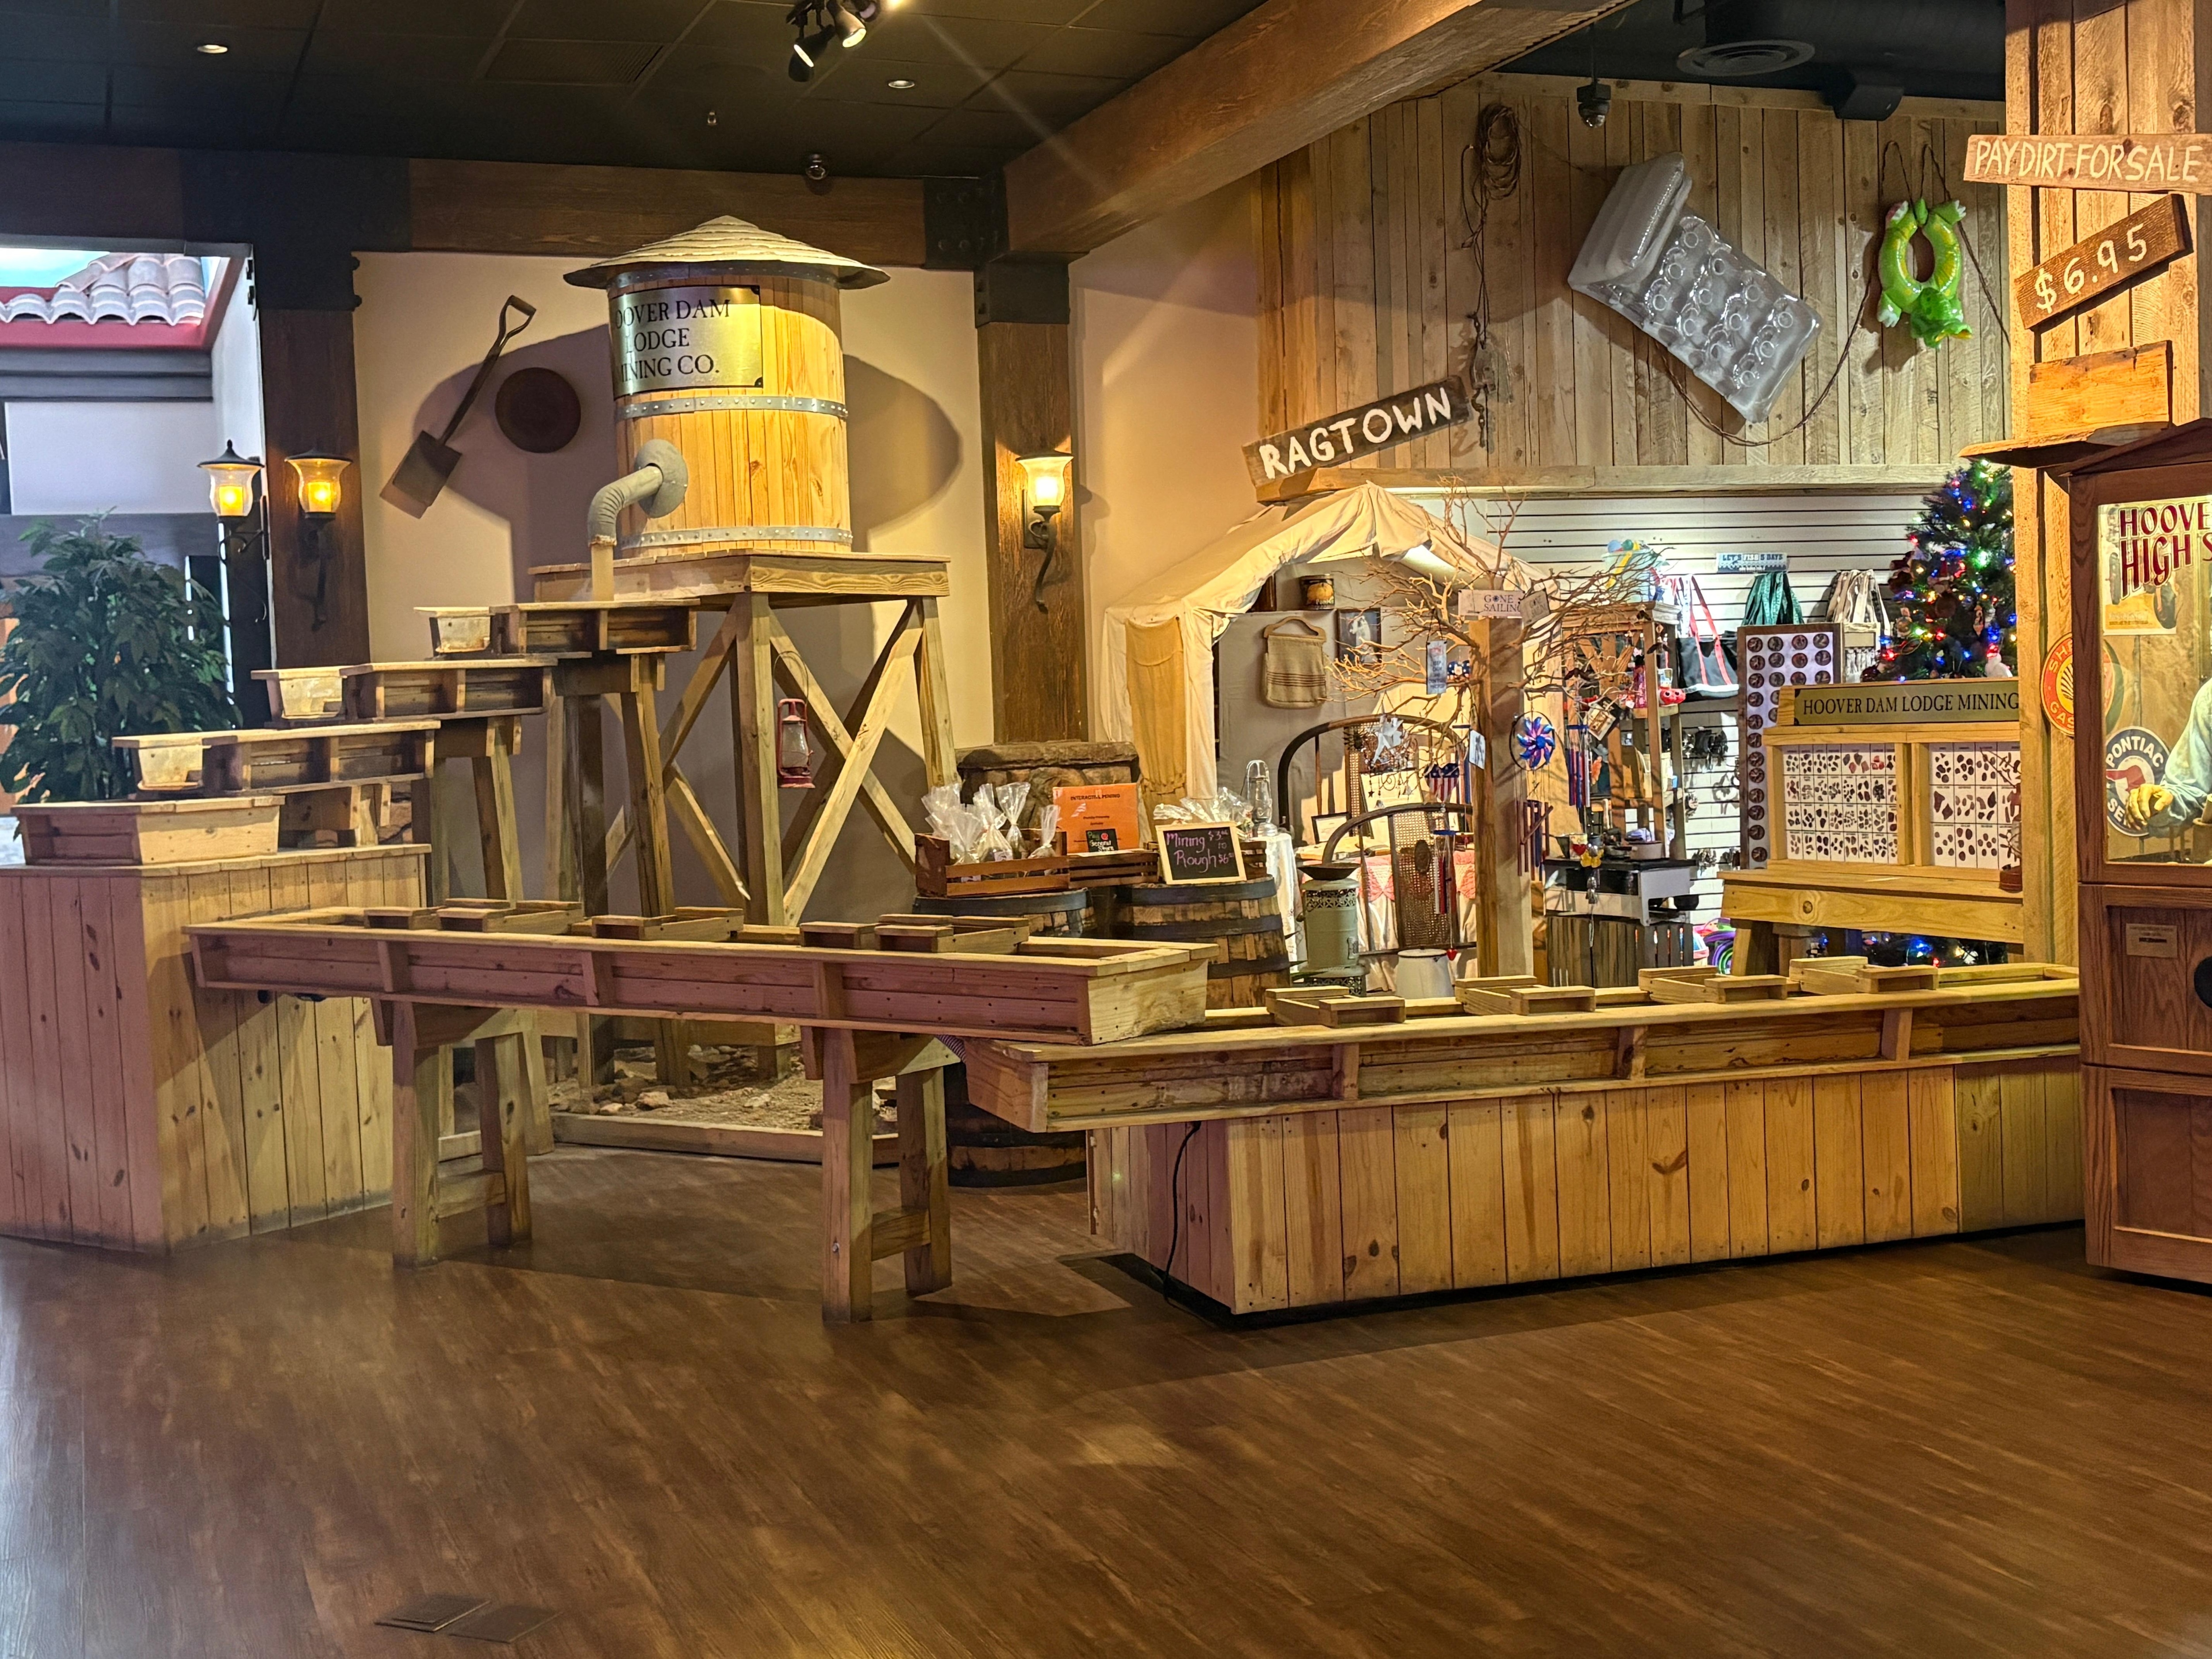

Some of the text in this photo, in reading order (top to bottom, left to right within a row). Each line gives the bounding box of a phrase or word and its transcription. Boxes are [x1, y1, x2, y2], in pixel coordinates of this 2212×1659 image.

[2074, 143, 2124, 180] FOR
[2125, 145, 2203, 181] SALE
[2035, 223, 2147, 314] $6.95
[676, 299, 730, 319] DAM
[622, 354, 719, 382] INING CO.
[1259, 387, 1451, 479] RAGTOWN
[2121, 534, 2191, 600] HIGH
[1803, 692, 2019, 715] HOOVER DAM LODGE MINING
[2106, 736, 2164, 768] PONTIAC
[1166, 833, 1205, 853] Mining
[1173, 849, 1217, 873] Rough
